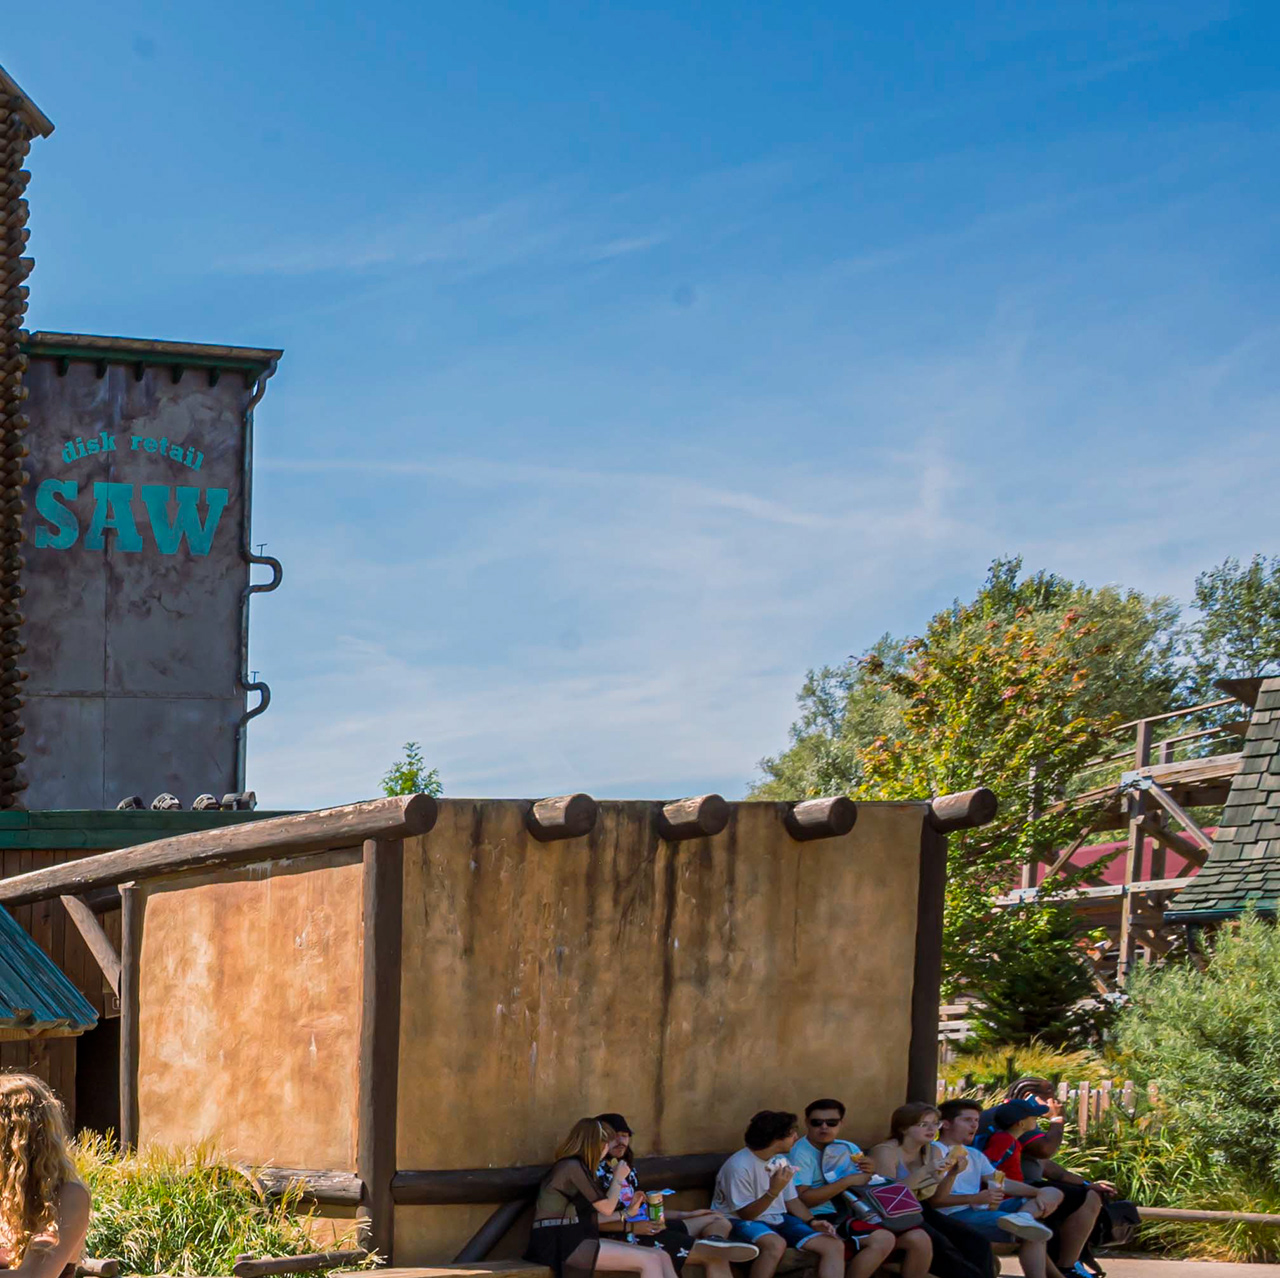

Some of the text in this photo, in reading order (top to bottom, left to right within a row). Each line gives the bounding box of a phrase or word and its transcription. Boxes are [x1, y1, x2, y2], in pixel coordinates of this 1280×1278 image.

[61, 431, 205, 472] disk retail
[35, 478, 229, 557] SAW
